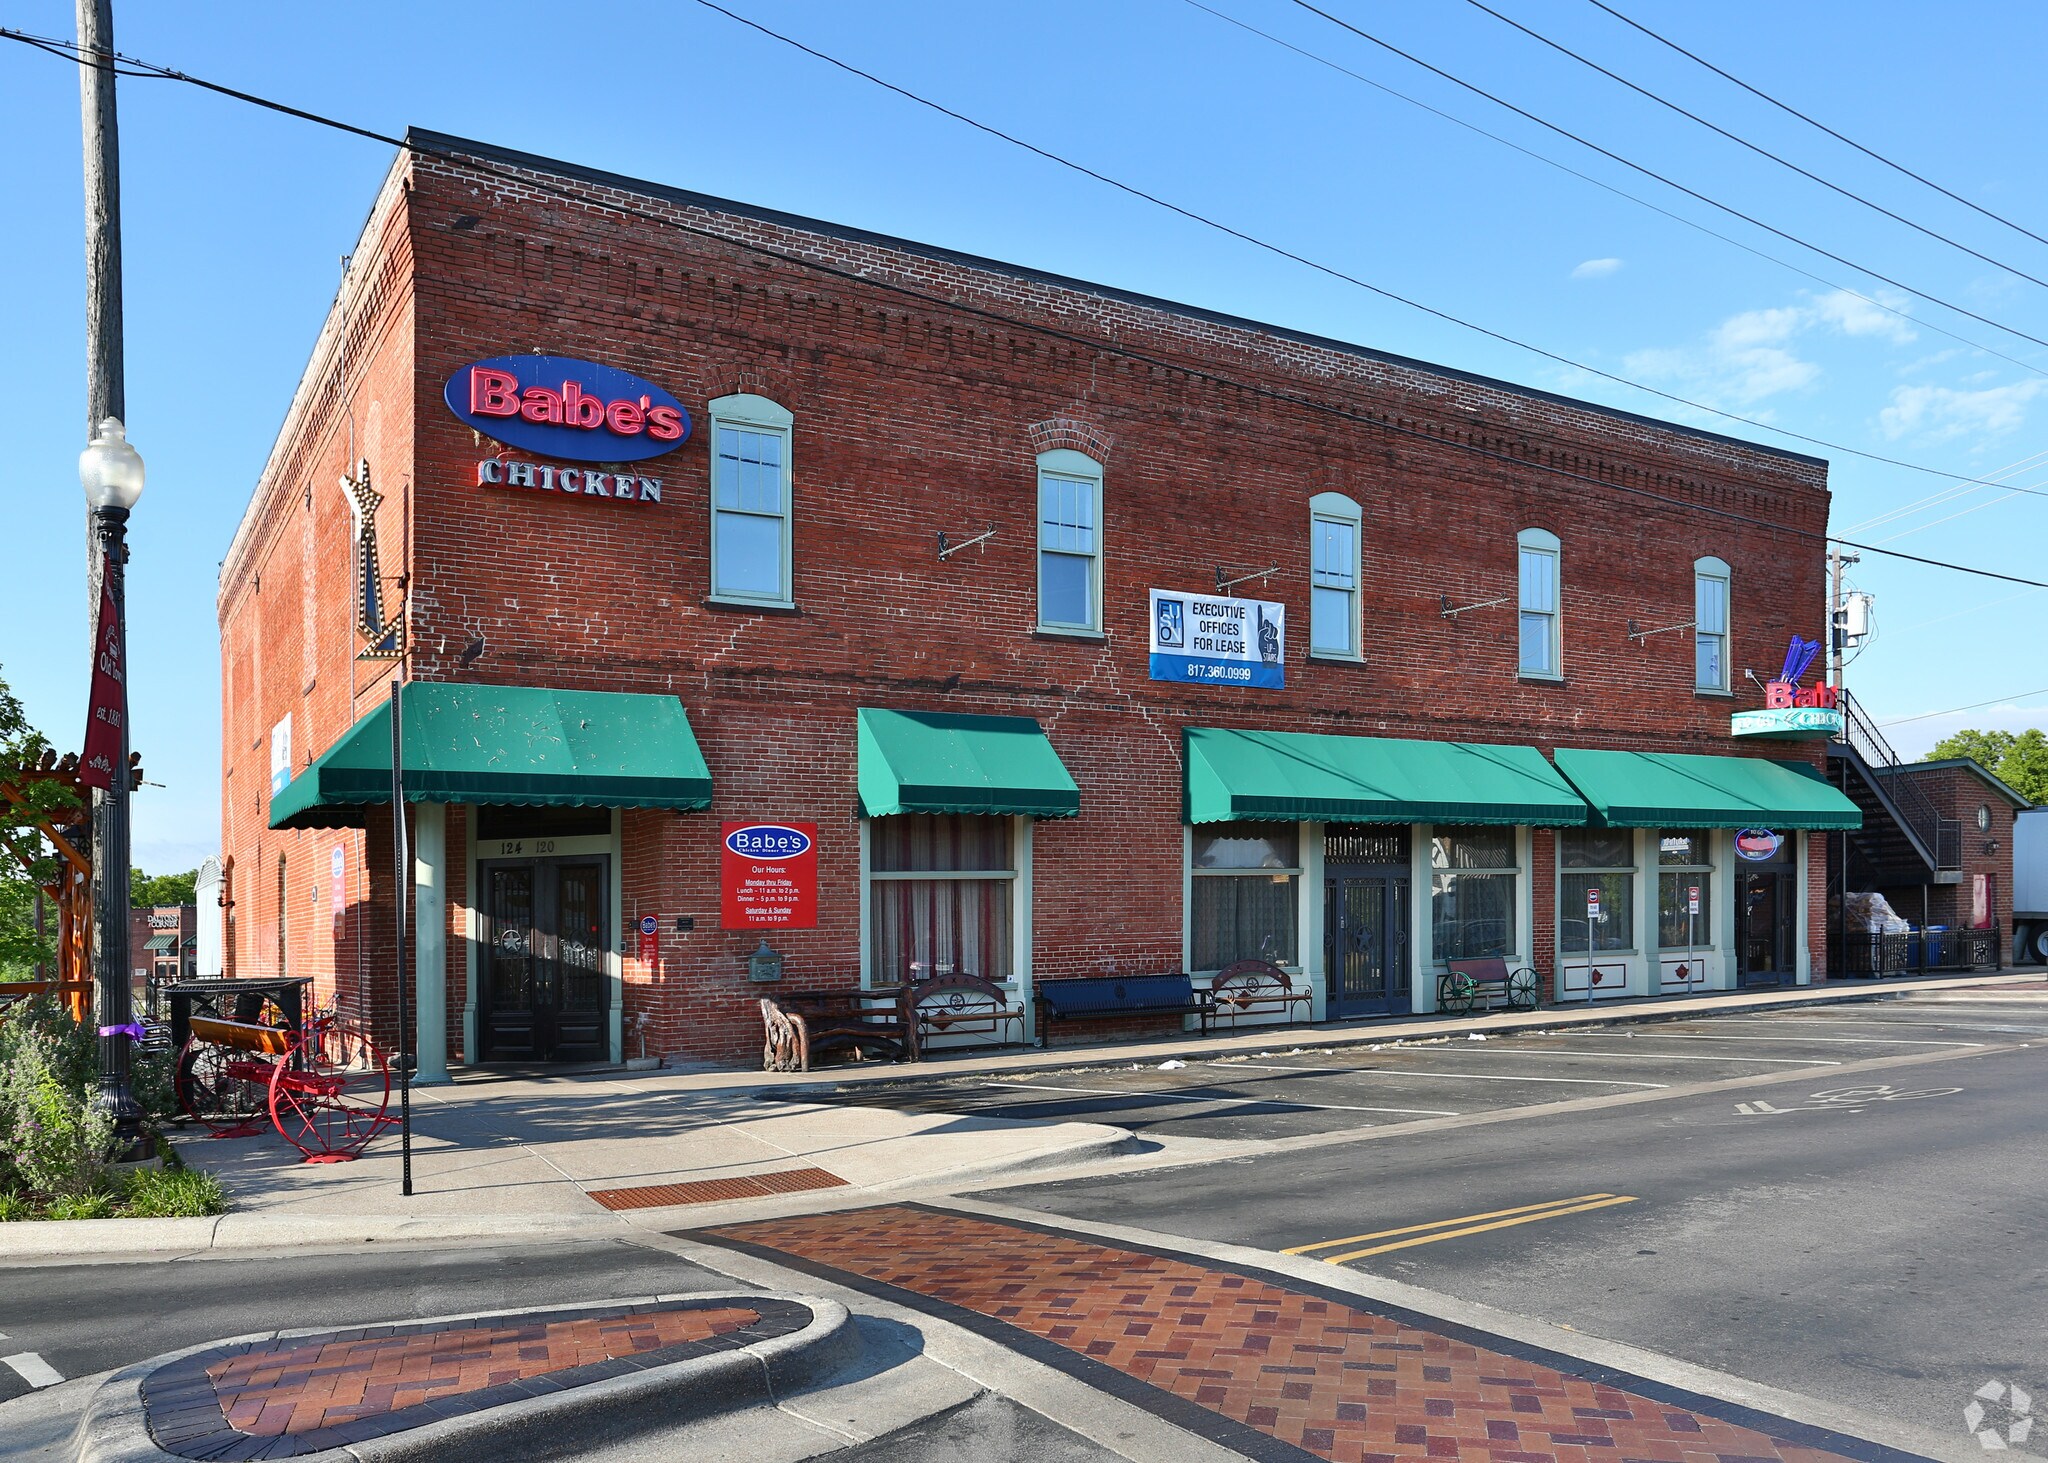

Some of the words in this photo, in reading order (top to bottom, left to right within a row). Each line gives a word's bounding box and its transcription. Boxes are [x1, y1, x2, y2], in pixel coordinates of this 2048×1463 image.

[470, 366, 684, 441] Babe's
[479, 457, 663, 503] CHICKEN
[1193, 602, 1245, 619] EXECUTIVE
[1200, 620, 1239, 636] OFFICES
[1194, 637, 1213, 650] FOR
[1216, 639, 1246, 654] LEASE
[100, 651, 112, 676] Old
[1187, 663, 1251, 680] 817.360.0999
[501, 841, 522, 855] 124
[536, 840, 555, 853] 120
[736, 834, 801, 848] Babe's
